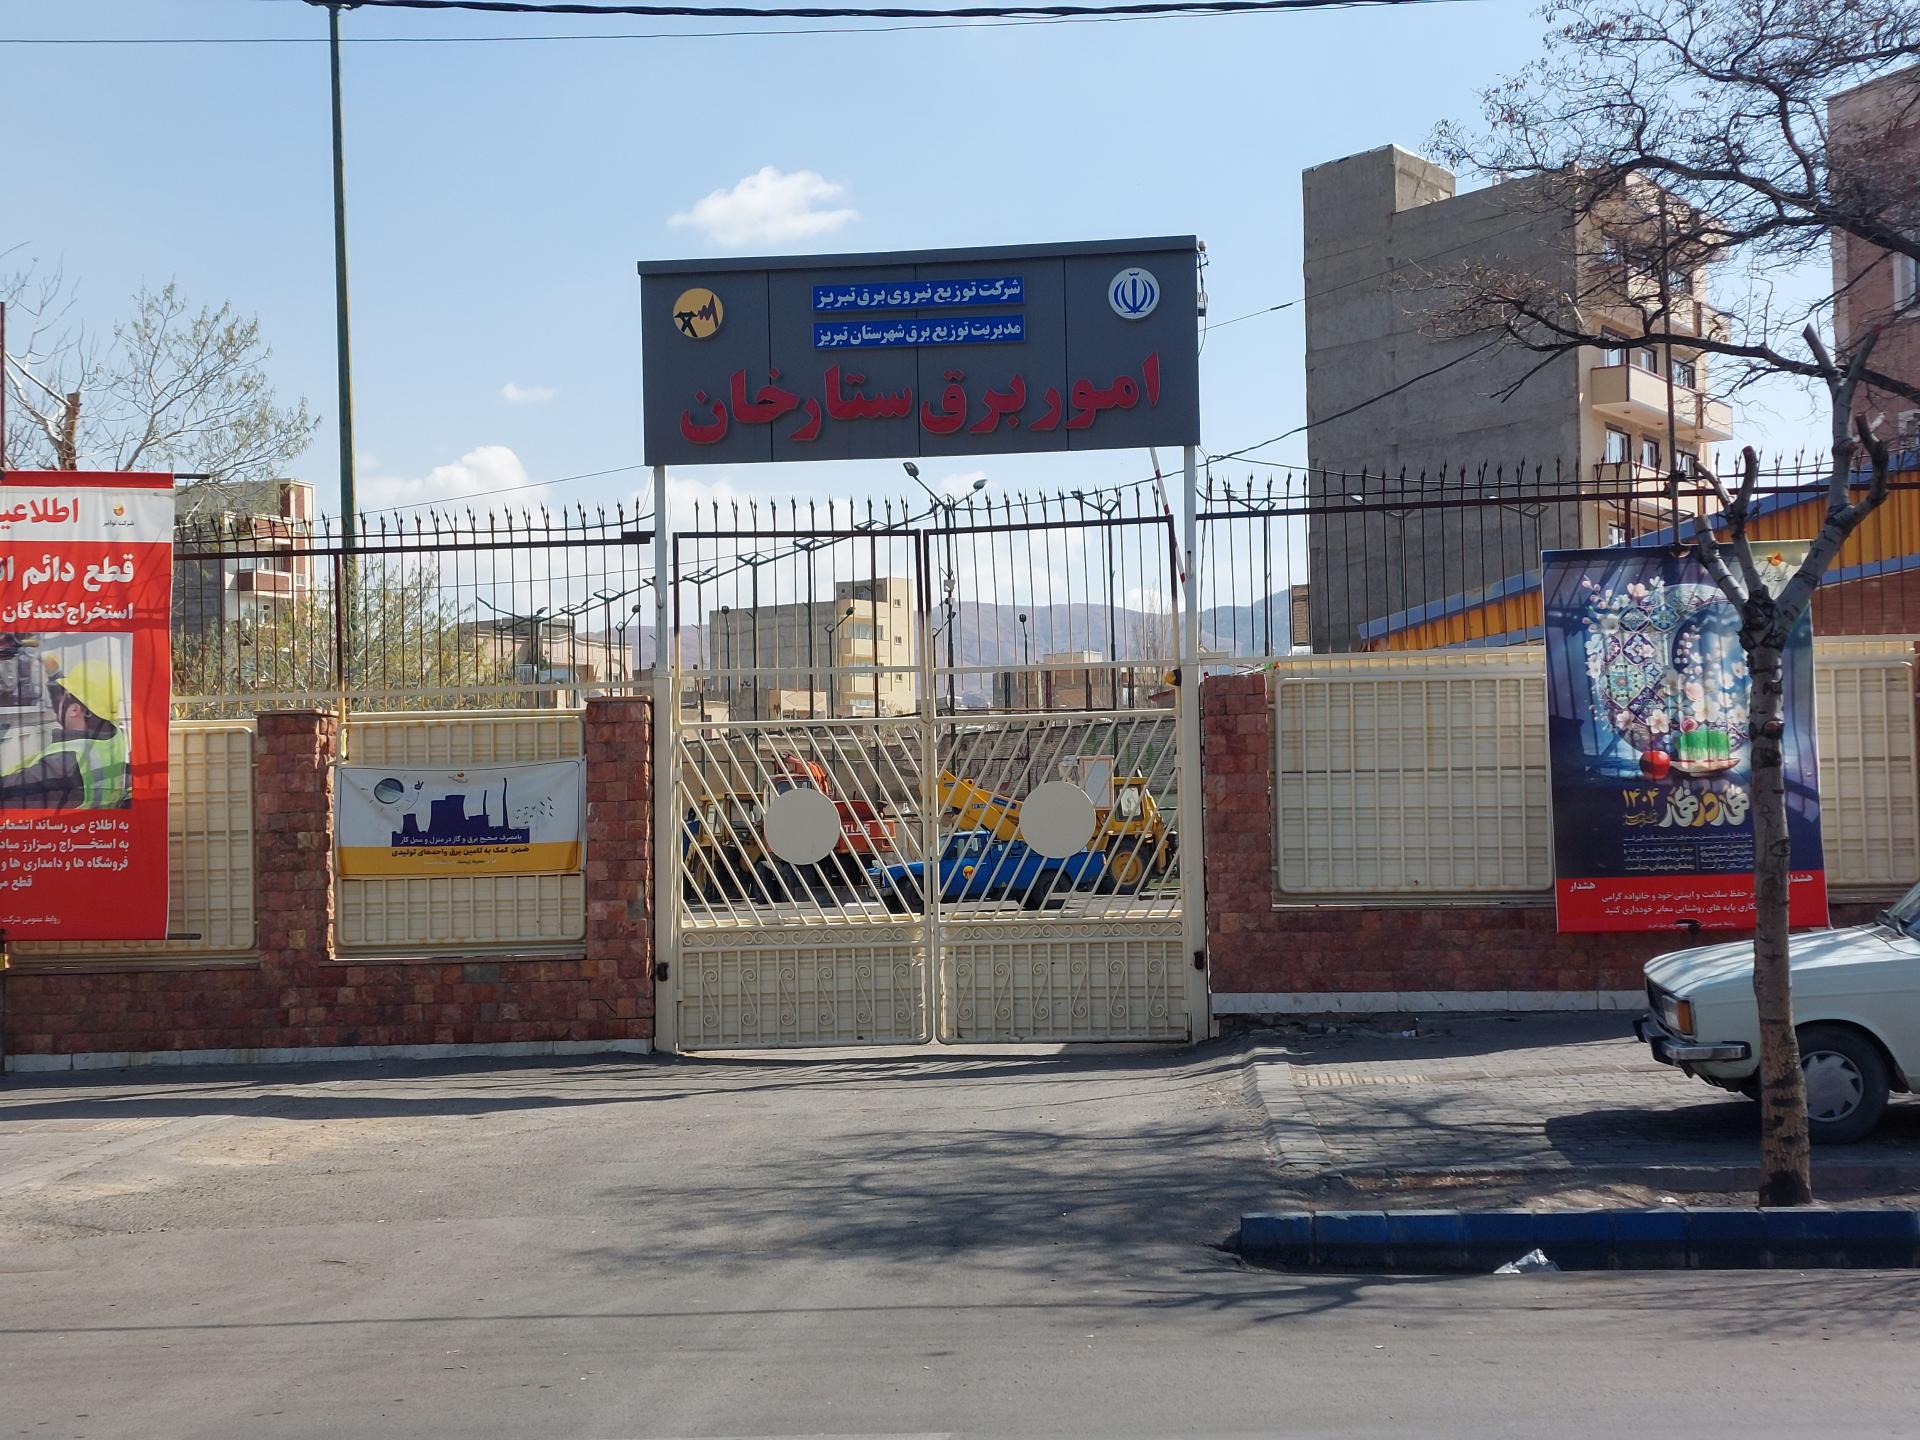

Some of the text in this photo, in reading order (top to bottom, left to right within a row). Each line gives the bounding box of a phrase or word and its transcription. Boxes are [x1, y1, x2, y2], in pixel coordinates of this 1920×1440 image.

[816, 279, 1020, 309] شرکت توزیع نیروی برق تبریز
[817, 321, 1021, 347] مدیریت توزیع برق شهرستان تبریز
[1028, 351, 1160, 431] امور
[919, 368, 1027, 434] برق
[0, 496, 79, 530] اطلاعی
[22, 553, 75, 592] دائم
[83, 553, 134, 592] قطع
[2, 600, 134, 625] استخراج کنندگان
[1622, 788, 1659, 808] ۱۴۰۴
[35, 818, 68, 834] رساند
[70, 823, 86, 833] می
[88, 818, 116, 833] اطلاع
[118, 820, 129, 833] به
[22, 838, 57, 852] رمزارز
[59, 837, 116, 852] استخراج
[118, 839, 129, 852] به
[1, 856, 129, 872] فروشگاه ها و دامداری ها و
[11, 875, 33, 891] قطع
[1787, 873, 1813, 885] هشدار
[1569, 881, 1596, 892] هشدار
[1601, 891, 1622, 902] گرامی
[1624, 891, 1650, 901] خانواده
[1657, 892, 1672, 901] خود
[1674, 890, 1695, 900] ایمنی
[1702, 889, 1727, 898] سلامت
[1730, 889, 1747, 898] حفظ
[1604, 905, 1621, 915] کنید
[1622, 905, 1653, 916] خودداری
[1675, 904, 1705, 915] روشنایی
[1706, 904, 1721, 913] های
